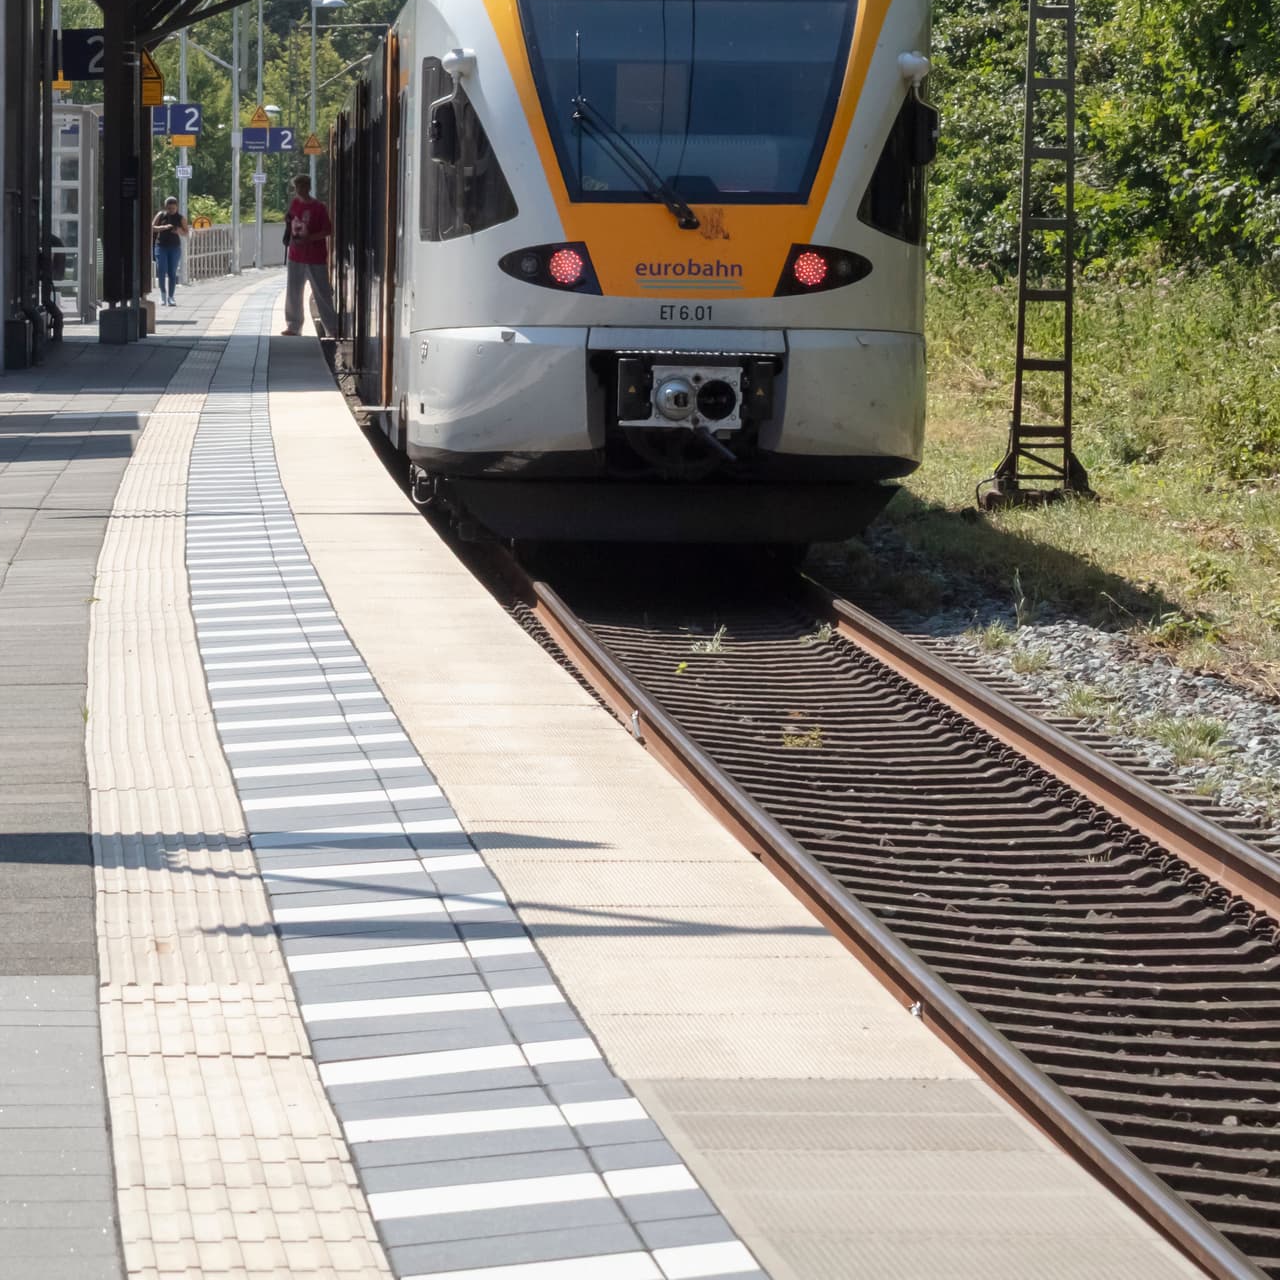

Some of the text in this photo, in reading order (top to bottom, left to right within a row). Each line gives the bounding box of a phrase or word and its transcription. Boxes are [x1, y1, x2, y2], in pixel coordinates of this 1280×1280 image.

[87, 35, 104, 73] 2
[184, 107, 199, 131] 2
[280, 130, 292, 149] 2
[635, 258, 743, 277] eurobahn
[660, 305, 713, 321] ET 6.01
